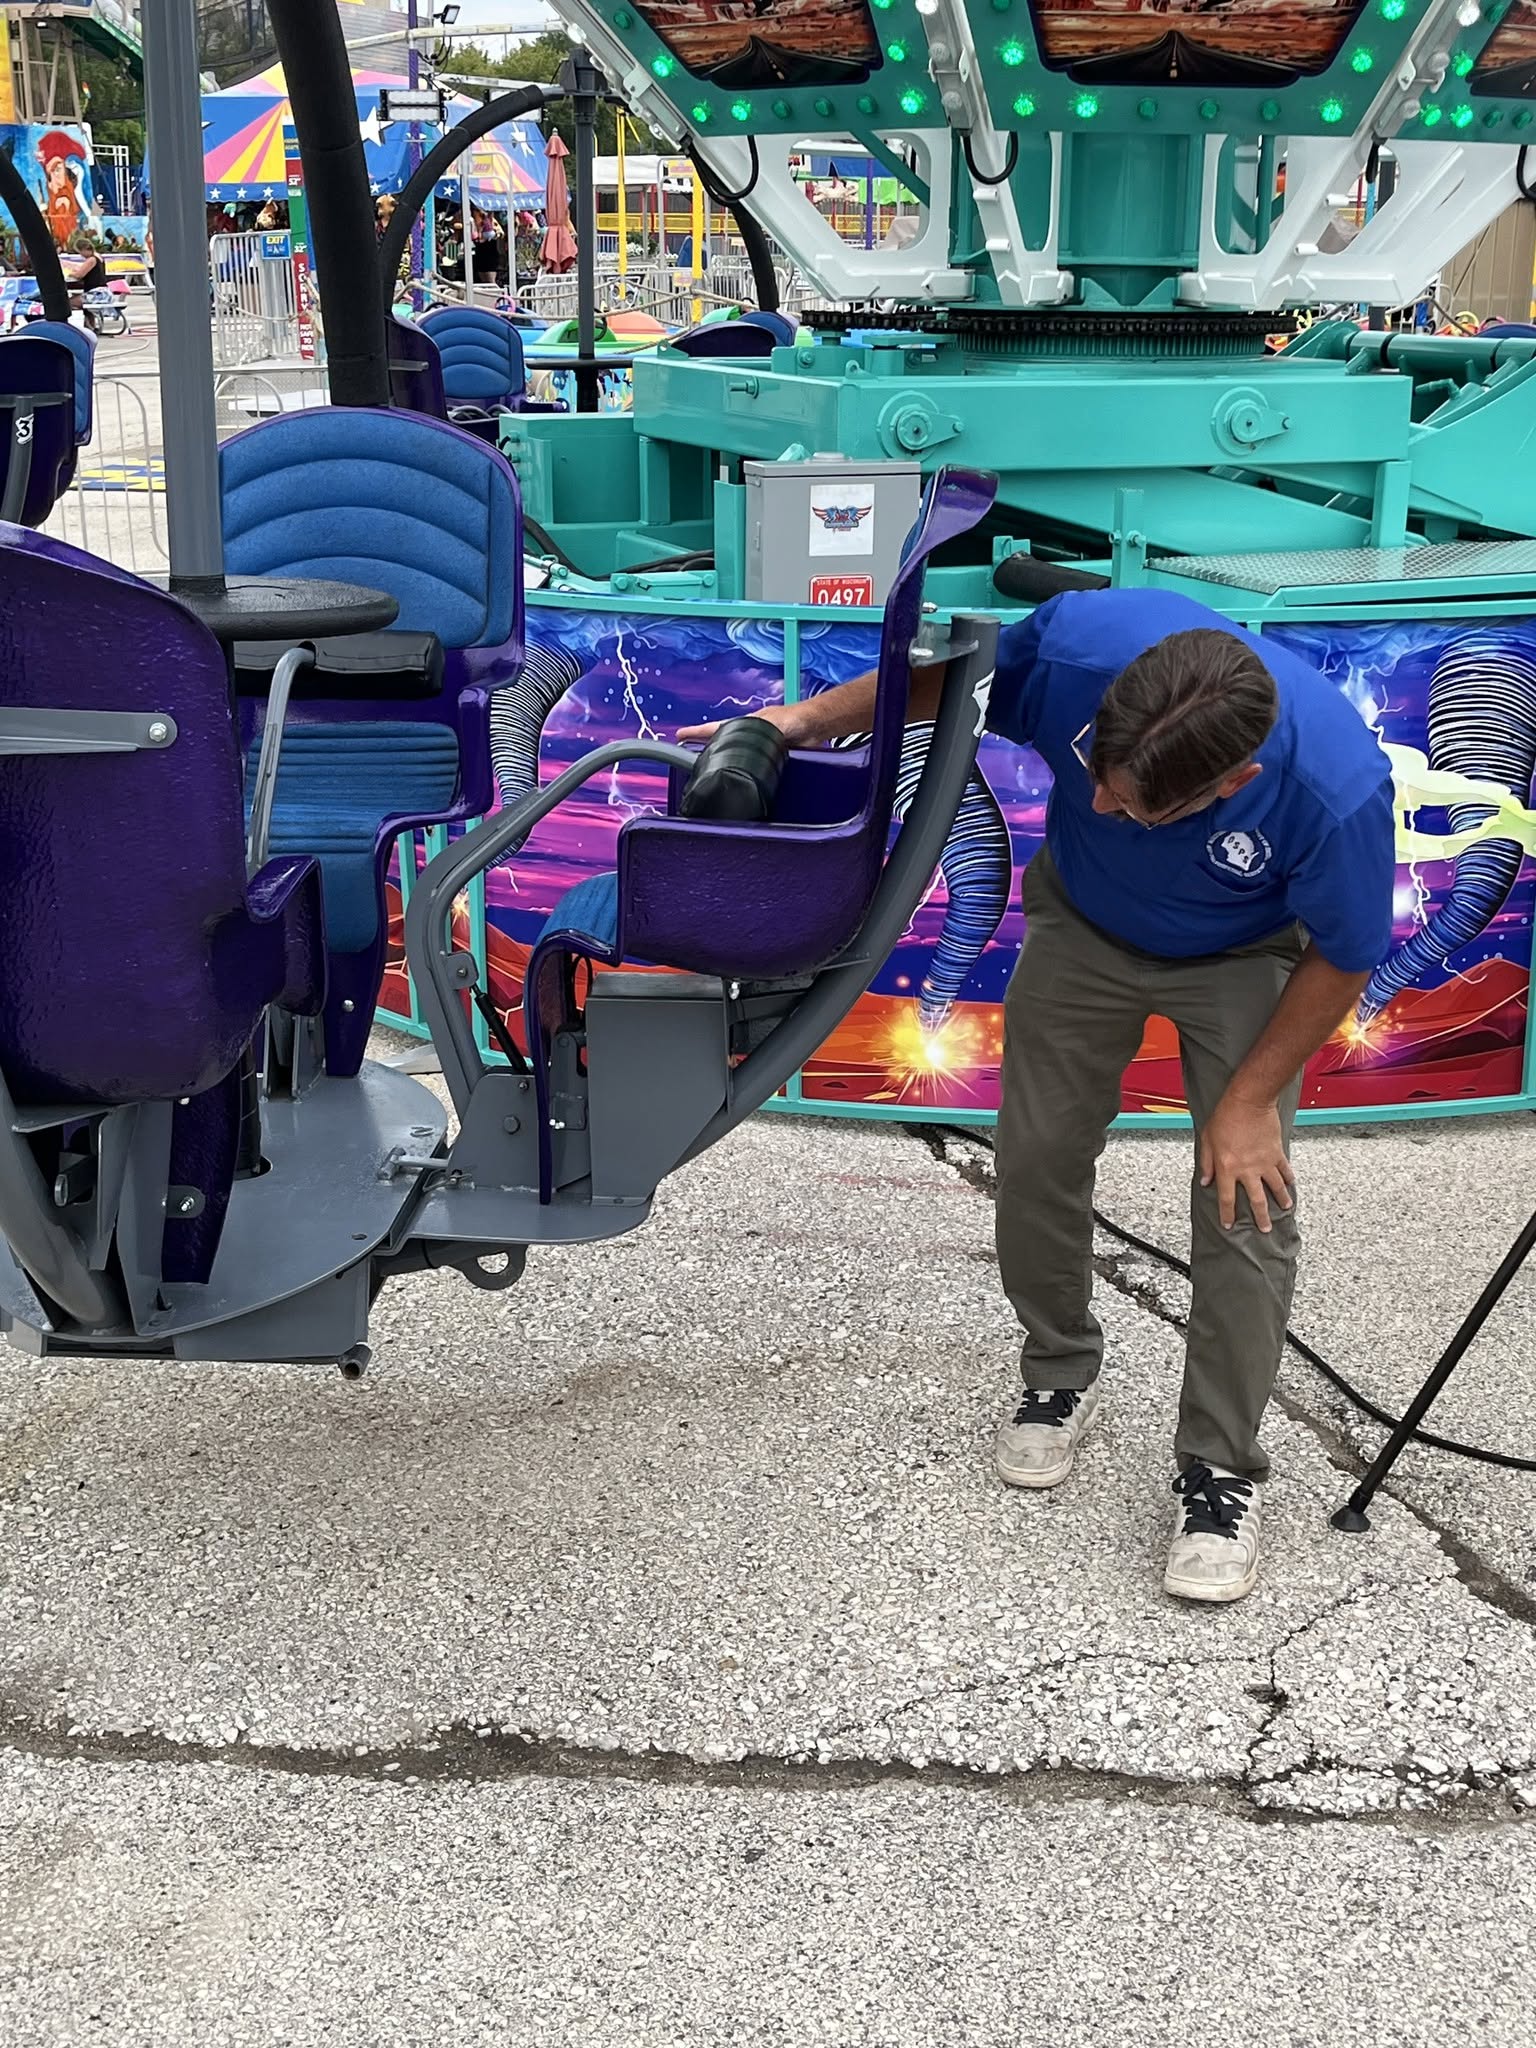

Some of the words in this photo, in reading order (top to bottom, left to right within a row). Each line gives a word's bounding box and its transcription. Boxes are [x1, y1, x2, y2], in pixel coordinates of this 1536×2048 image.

[266, 235, 285, 244] EXIT
[817, 587, 865, 606] 0497
[1227, 835, 1250, 865] DSPS
